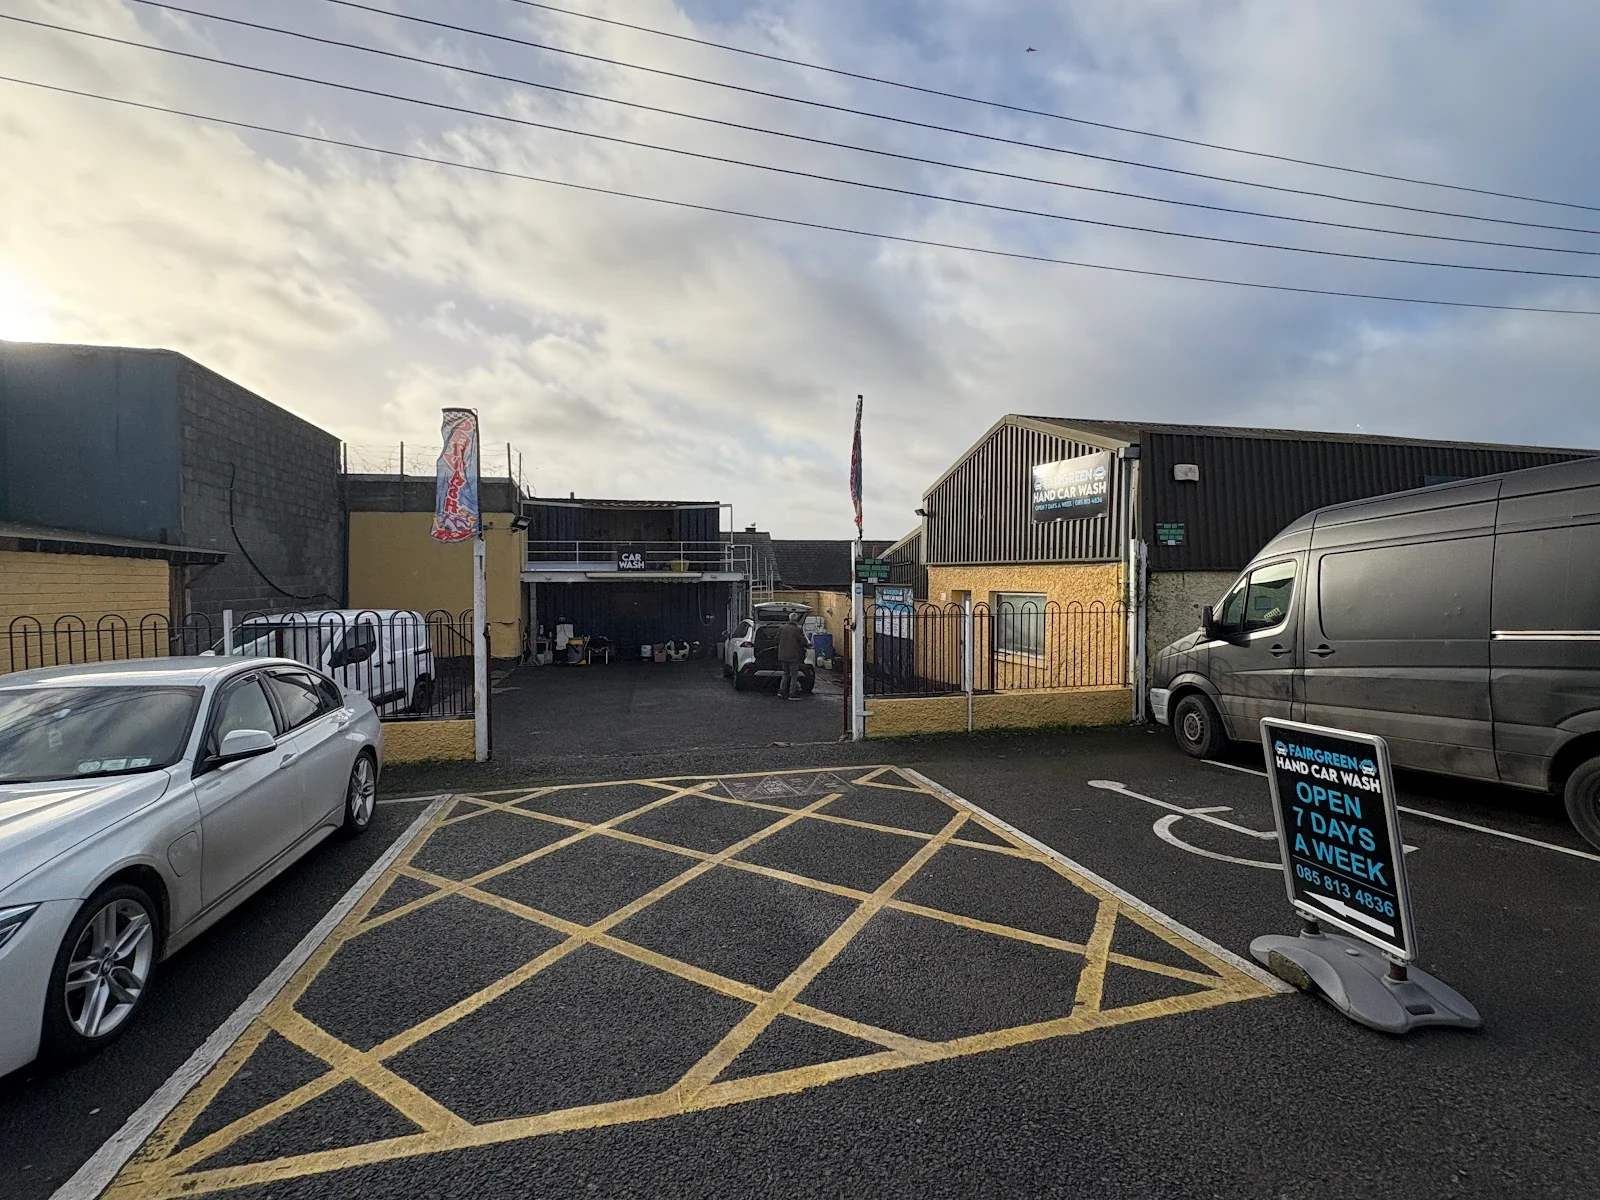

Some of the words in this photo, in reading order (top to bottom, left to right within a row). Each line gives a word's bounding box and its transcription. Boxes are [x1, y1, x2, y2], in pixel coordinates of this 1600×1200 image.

[1033, 489, 1056, 503] HAND
[1057, 486, 1076, 499] CAR
[1078, 481, 1107, 496] WASH
[619, 561, 645, 569] WASH
[621, 553, 642, 561] CAR
[1276, 756, 1309, 775] HAND
[1311, 765, 1339, 784] CAR
[1339, 771, 1381, 794] WASH
[1288, 743, 1359, 771] FAIRGREEN
[1296, 781, 1363, 820] OPEN
[1292, 806, 1304, 828] 7
[1311, 811, 1376, 852] DAYS
[1294, 833, 1310, 857] A
[1311, 838, 1388, 887] WEEK
[1296, 864, 1321, 886] 085
[1324, 875, 1351, 899] 813
[1354, 889, 1395, 918] 4836
